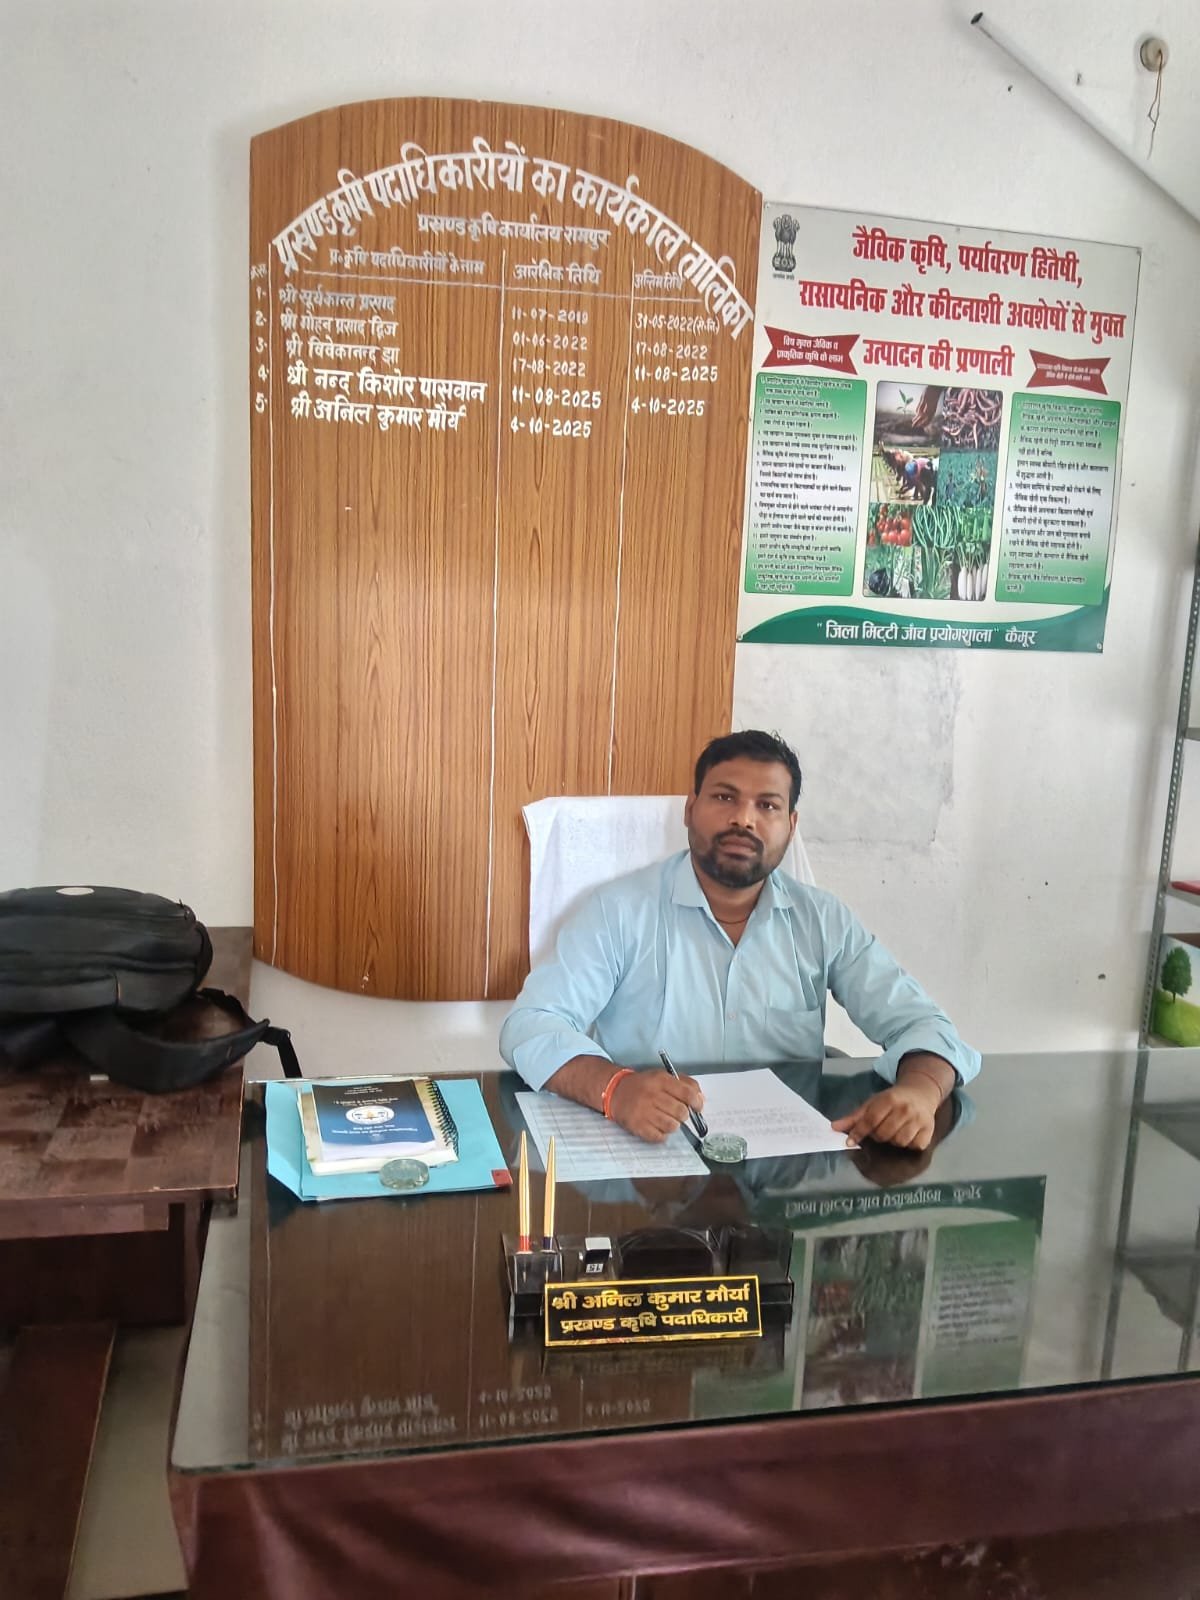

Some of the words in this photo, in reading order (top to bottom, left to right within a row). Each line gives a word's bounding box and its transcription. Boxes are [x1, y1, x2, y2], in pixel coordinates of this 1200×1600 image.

[271, 197, 337, 278] प्रखण्ड
[326, 167, 375, 236] कृषि
[364, 136, 530, 209] पदाधिकारीयों
[531, 157, 571, 203] का
[572, 169, 690, 265] कार्यकाल
[678, 241, 754, 341] तालिका
[852, 225, 906, 262] जैविक
[909, 234, 952, 276] कृषि,
[958, 240, 1028, 278] पर्यावरण
[1030, 247, 1083, 288] हितैषी,
[798, 278, 888, 315] रासायनिक
[891, 283, 925, 318] और
[928, 287, 1003, 326] कीटनाशी
[1006, 297, 1069, 332] अवशेषों
[1071, 303, 1087, 334] से
[1089, 310, 1126, 345] मुक्त
[513, 331, 588, 350] 01-06-2022
[512, 357, 586, 377] 17-08-2022
[863, 338, 924, 370] उत्पादन
[928, 339, 955, 372] की
[956, 343, 1015, 378] प्रणाली
[287, 359, 308, 387] श्री
[313, 368, 354, 396] नन्द
[357, 366, 417, 402] किशोर
[418, 376, 488, 404] पासवान
[634, 365, 718, 383] 11-08-2025
[511, 385, 602, 409] 11-08-2025
[631, 396, 705, 417] 4-10-2025
[290, 390, 312, 420] श्री
[313, 394, 373, 425] अनिल
[375, 404, 424, 432] कुमार
[510, 415, 593, 438] 4-10-2025
[1005, 628, 1038, 647] कैमूर
[551, 1291, 577, 1310] श्री
[582, 1289, 643, 1310] अनिल
[647, 1290, 703, 1311] कुमार
[705, 1283, 751, 1305] मौर्या
[560, 1318, 615, 1334] प्रखण्ड
[620, 1312, 657, 1333] कृषि
[661, 1307, 748, 1327] पदाधिकारी
